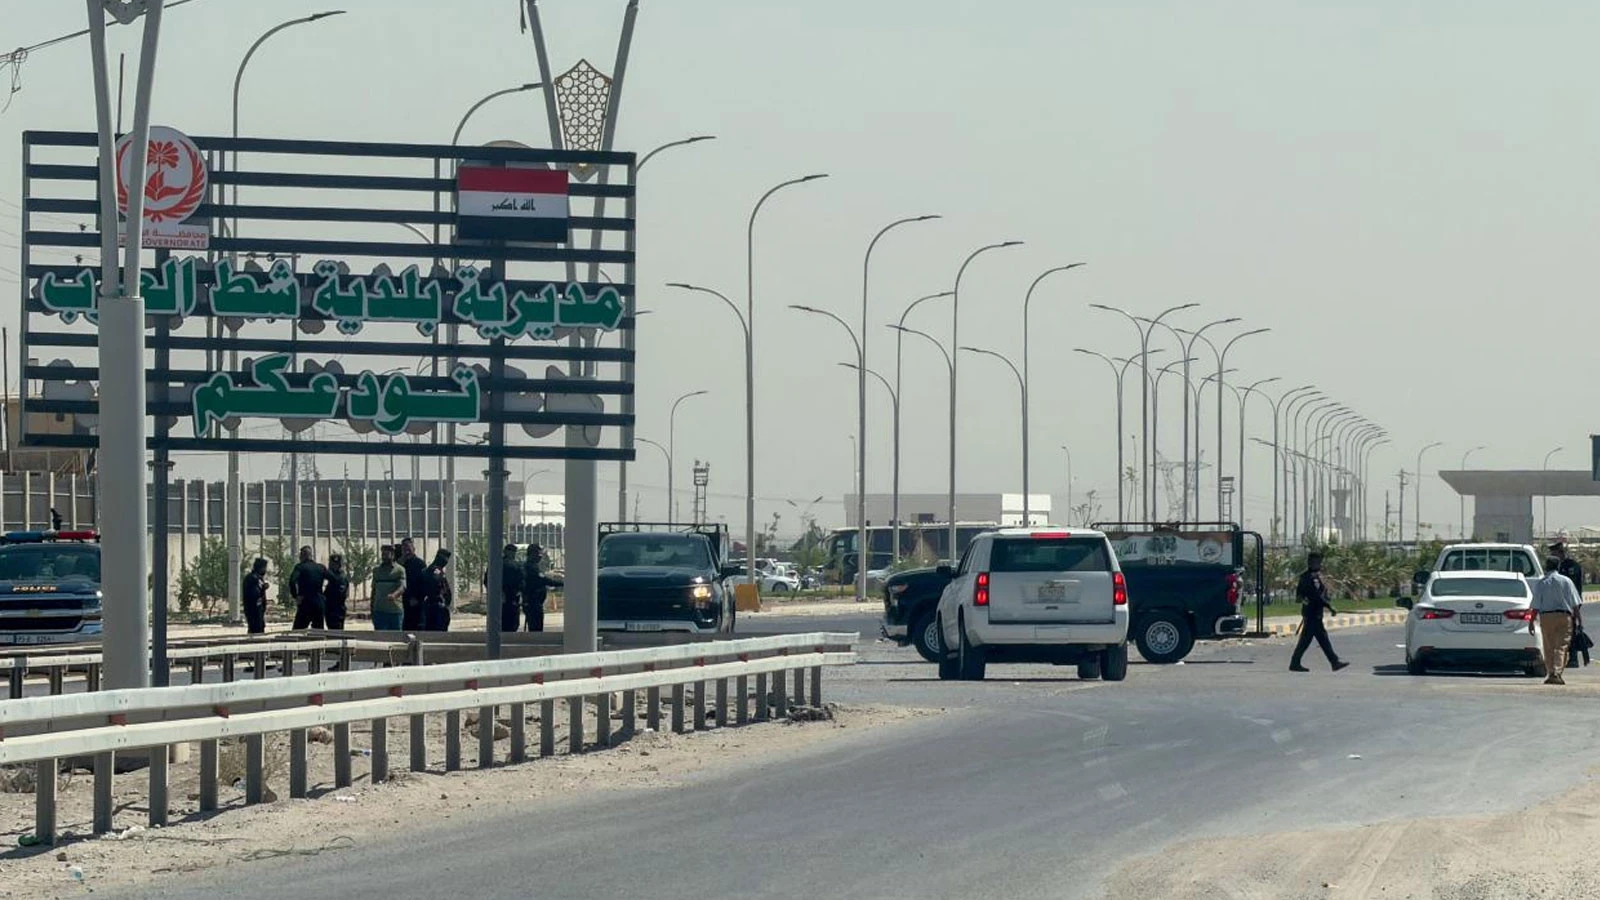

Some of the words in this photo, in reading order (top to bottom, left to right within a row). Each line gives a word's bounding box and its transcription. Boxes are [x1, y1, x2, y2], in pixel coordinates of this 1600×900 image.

[209, 257, 300, 318] شط
[312, 260, 441, 336] بلدية
[453, 266, 624, 340] مديرية
